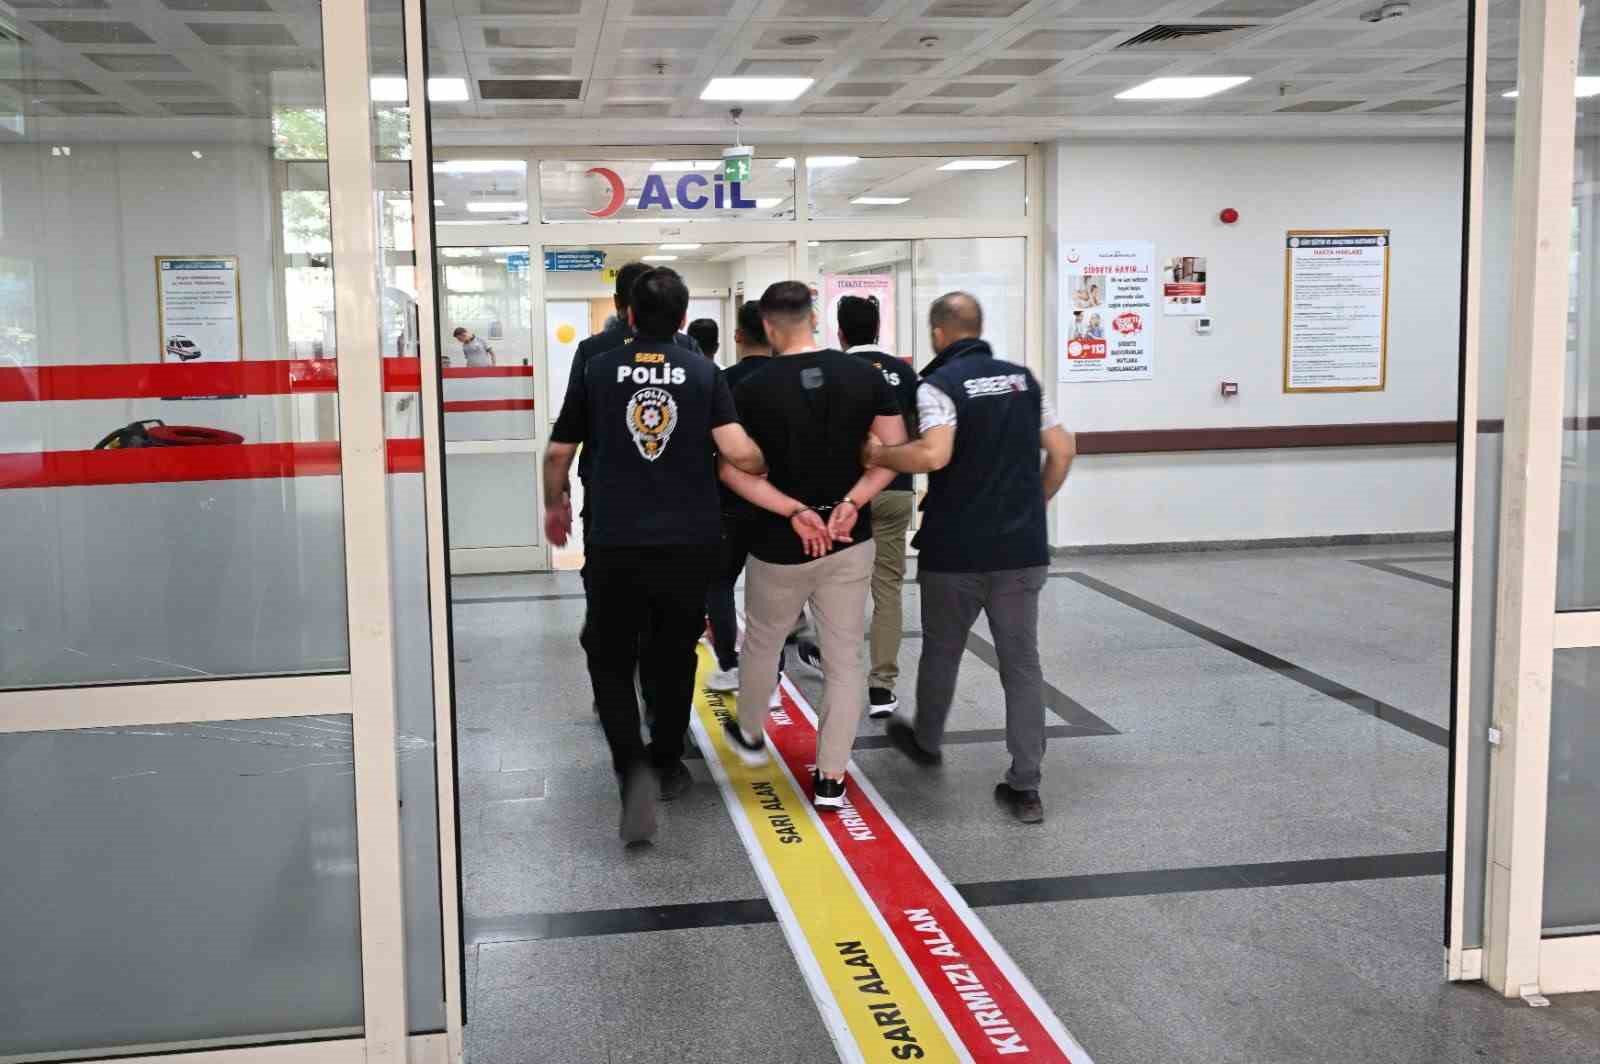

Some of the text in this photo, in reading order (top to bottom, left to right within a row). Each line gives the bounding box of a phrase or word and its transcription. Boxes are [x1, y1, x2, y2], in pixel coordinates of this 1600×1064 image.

[616, 362, 687, 385] POLİS
[751, 781, 802, 844] SARI ALAN
[835, 940, 925, 1060] SARI ALAN
[903, 908, 1029, 1056] KIRMIZI ALAN
